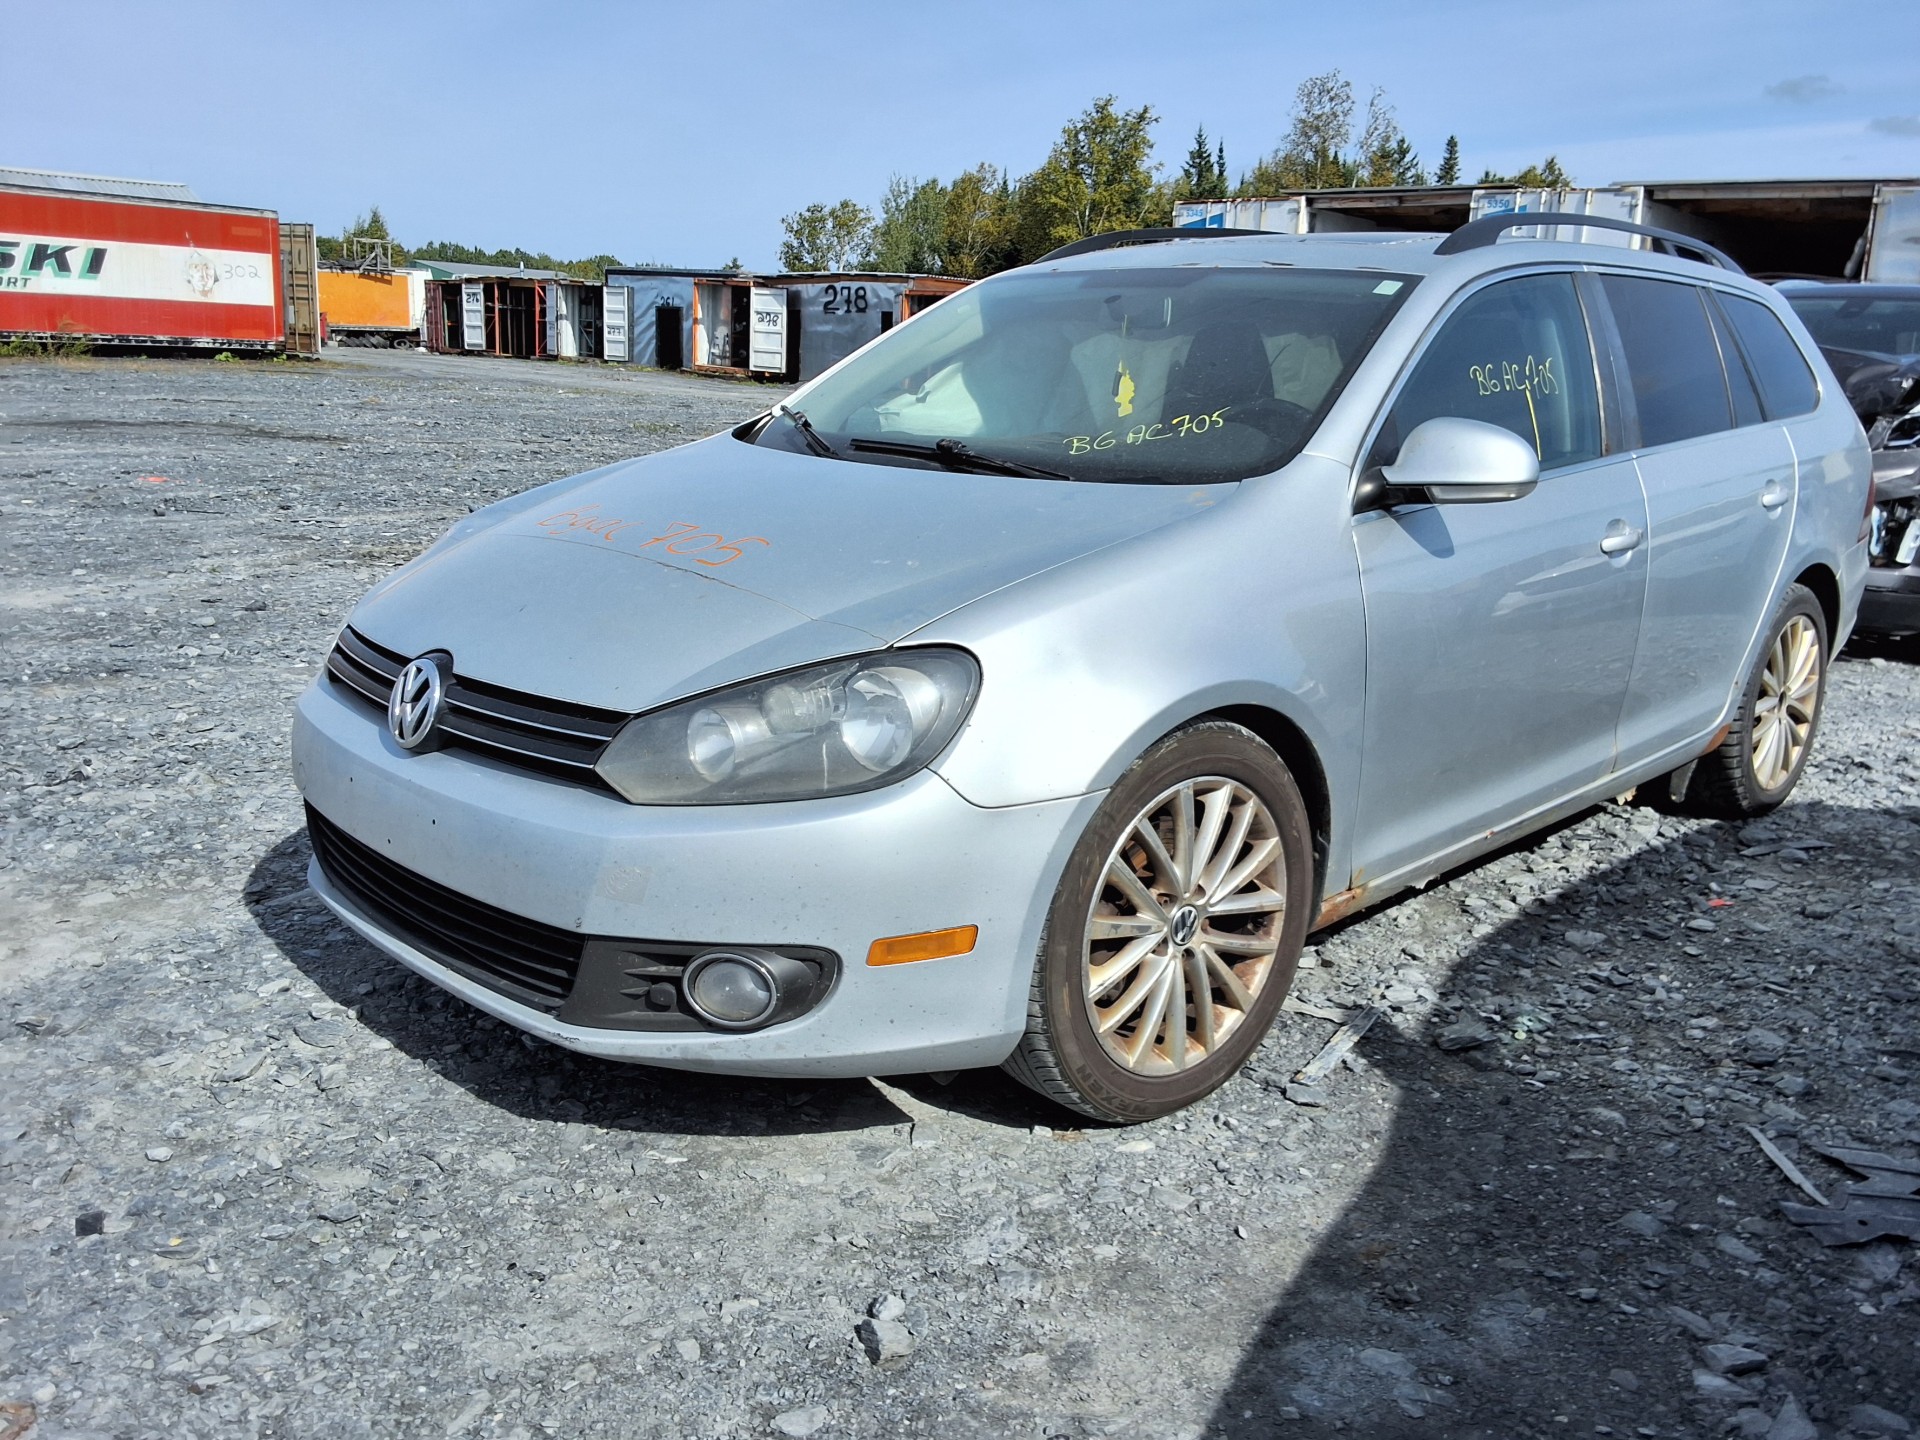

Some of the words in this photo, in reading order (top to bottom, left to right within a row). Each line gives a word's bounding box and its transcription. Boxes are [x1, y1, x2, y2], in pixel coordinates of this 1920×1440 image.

[1486, 199, 1510, 209] 5350
[223, 263, 262, 280] 302
[0, 275, 31, 288] RT
[822, 284, 868, 315] 278
[755, 312, 780, 327] 278
[639, 521, 771, 567] 705
